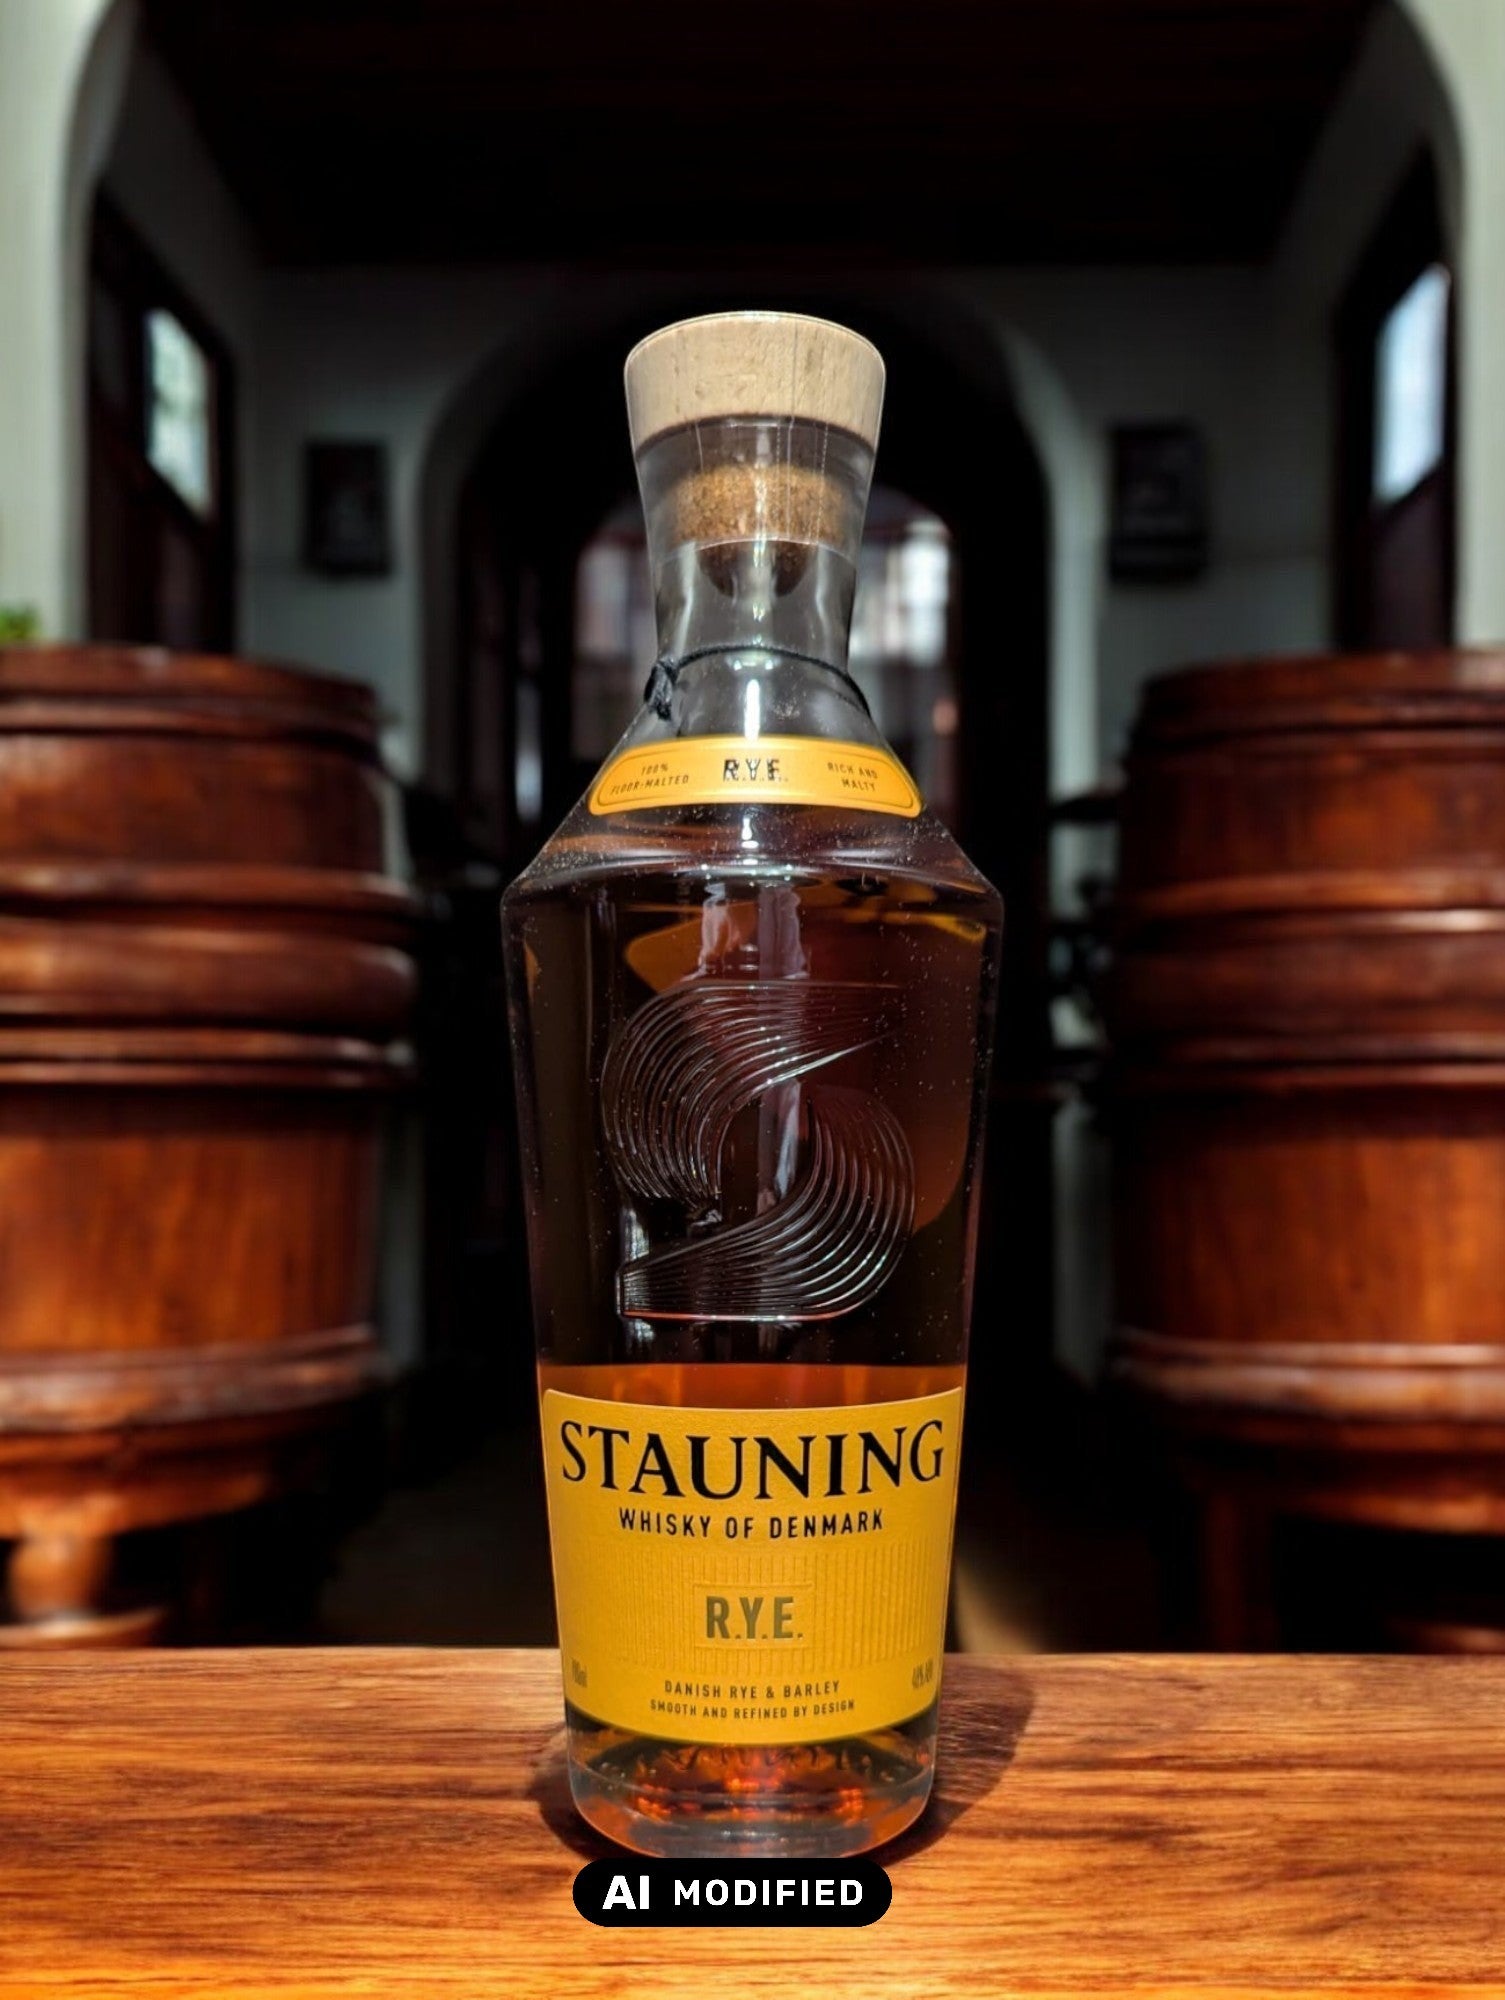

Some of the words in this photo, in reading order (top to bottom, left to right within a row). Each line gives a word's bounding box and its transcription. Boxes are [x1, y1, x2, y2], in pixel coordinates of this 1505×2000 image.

[842, 778, 876, 792] MALTY
[560, 1420, 943, 1500] STAUNING
[619, 1507, 711, 1538] WHISKY
[725, 1517, 754, 1539] OF
[770, 1508, 883, 1539] DENMARK
[706, 1596, 803, 1640] R.Y.E.
[664, 1680, 721, 1699] DANISH
[729, 1686, 758, 1699] RYE
[766, 1685, 774, 1698] &
[783, 1680, 840, 1698] BARLEY
[650, 1700, 697, 1716] SMOOTH
[702, 1707, 728, 1719] AND
[733, 1707, 787, 1719] REFINED
[793, 1706, 807, 1718] BY
[813, 1700, 855, 1715] DESIGN
